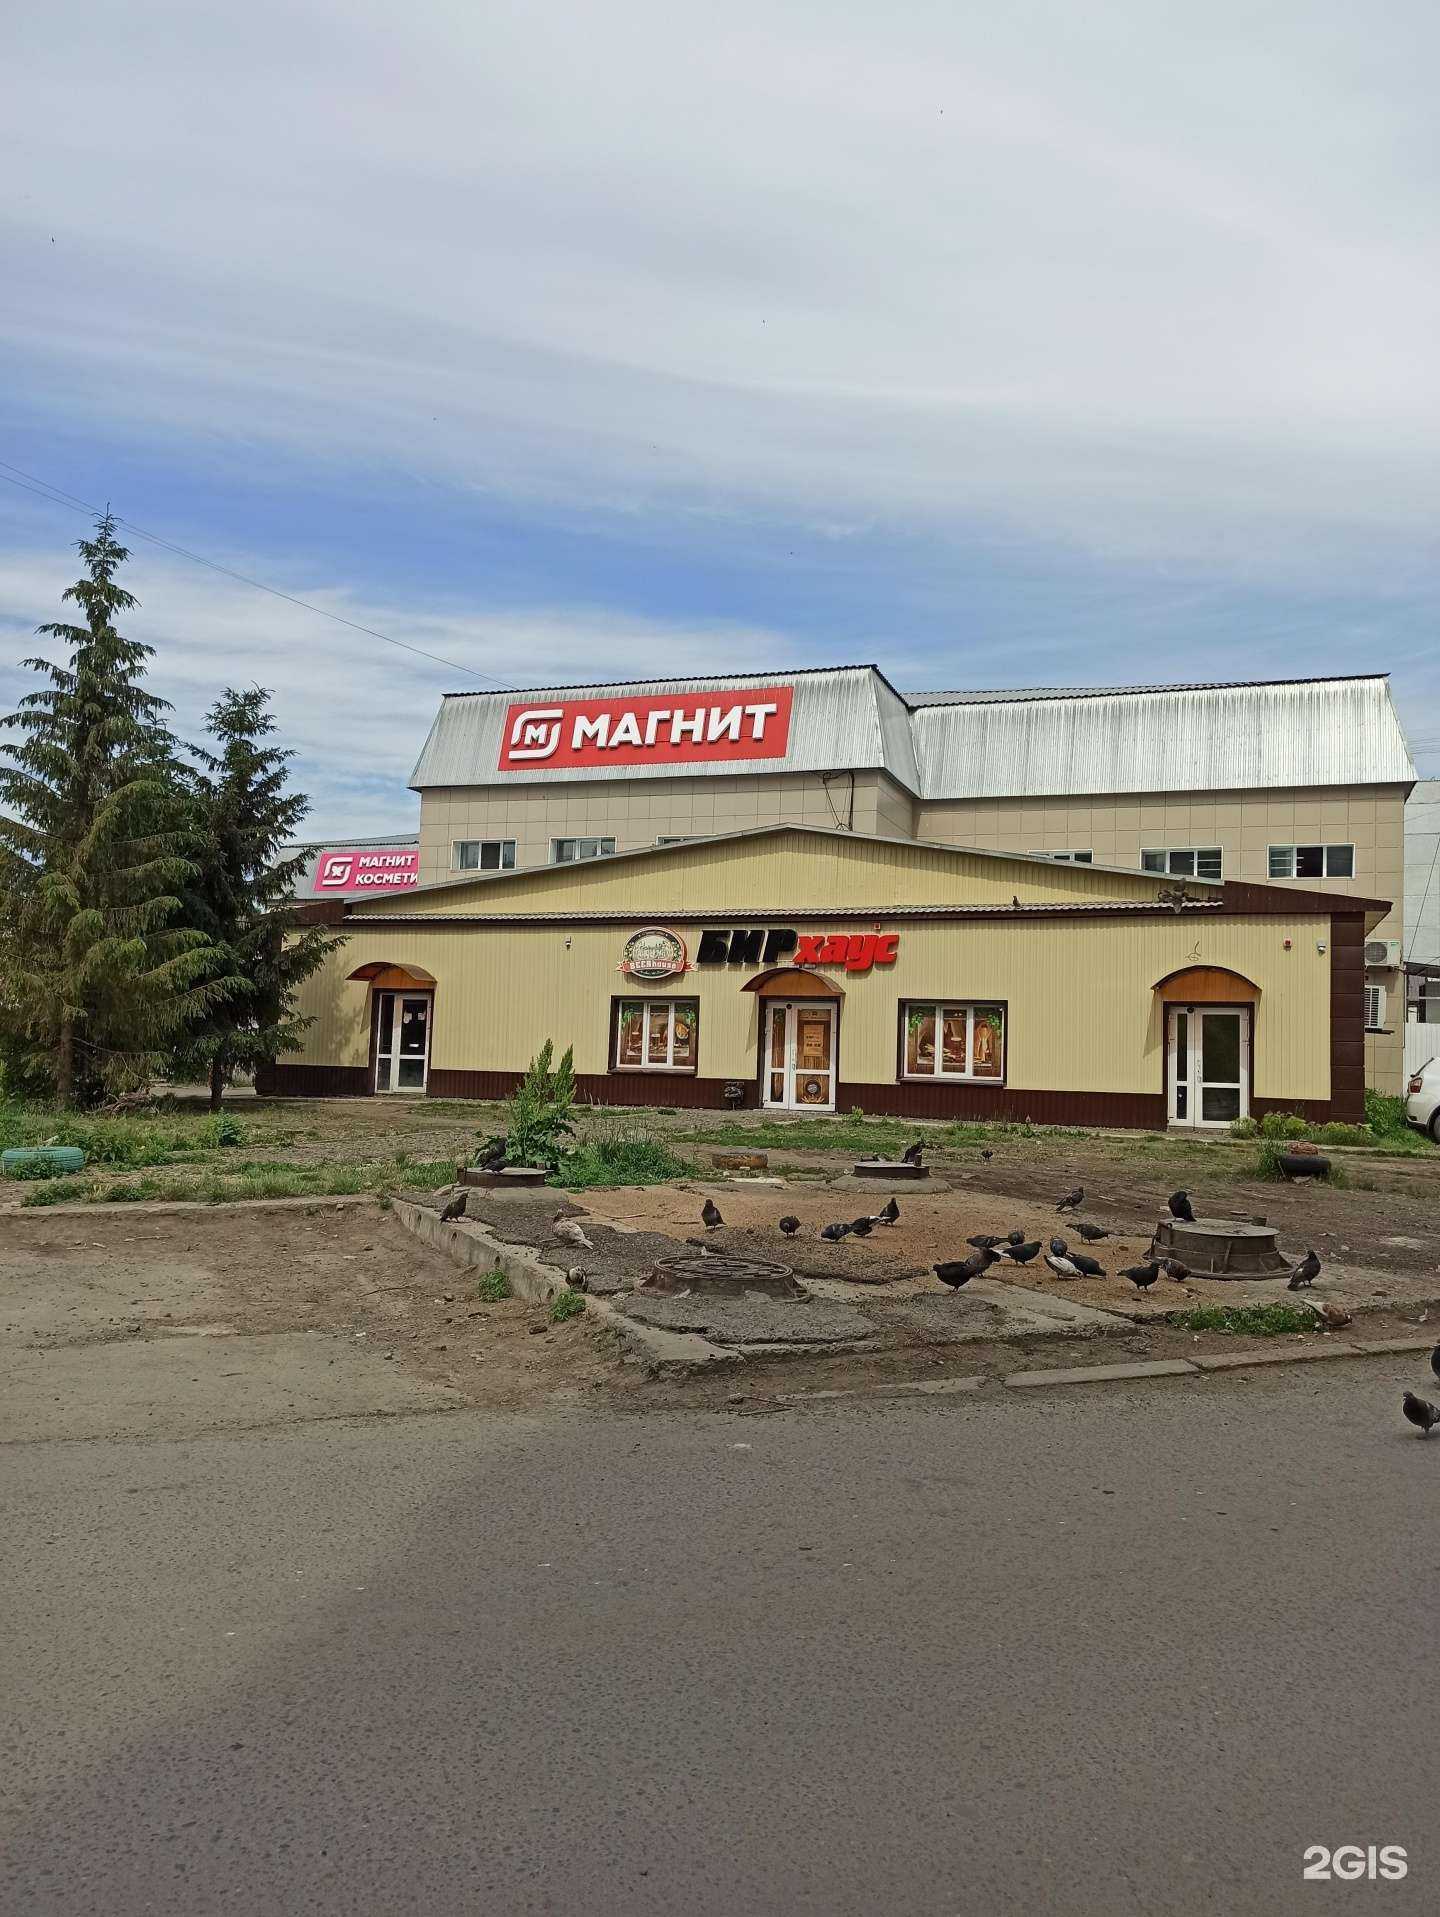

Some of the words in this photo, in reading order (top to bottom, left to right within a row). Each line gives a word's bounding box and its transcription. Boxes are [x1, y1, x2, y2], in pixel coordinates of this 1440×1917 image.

[571, 703, 777, 750] МАГНИТ
[358, 855, 415, 868] МАГНИТ
[696, 929, 900, 972] БИРхаус
